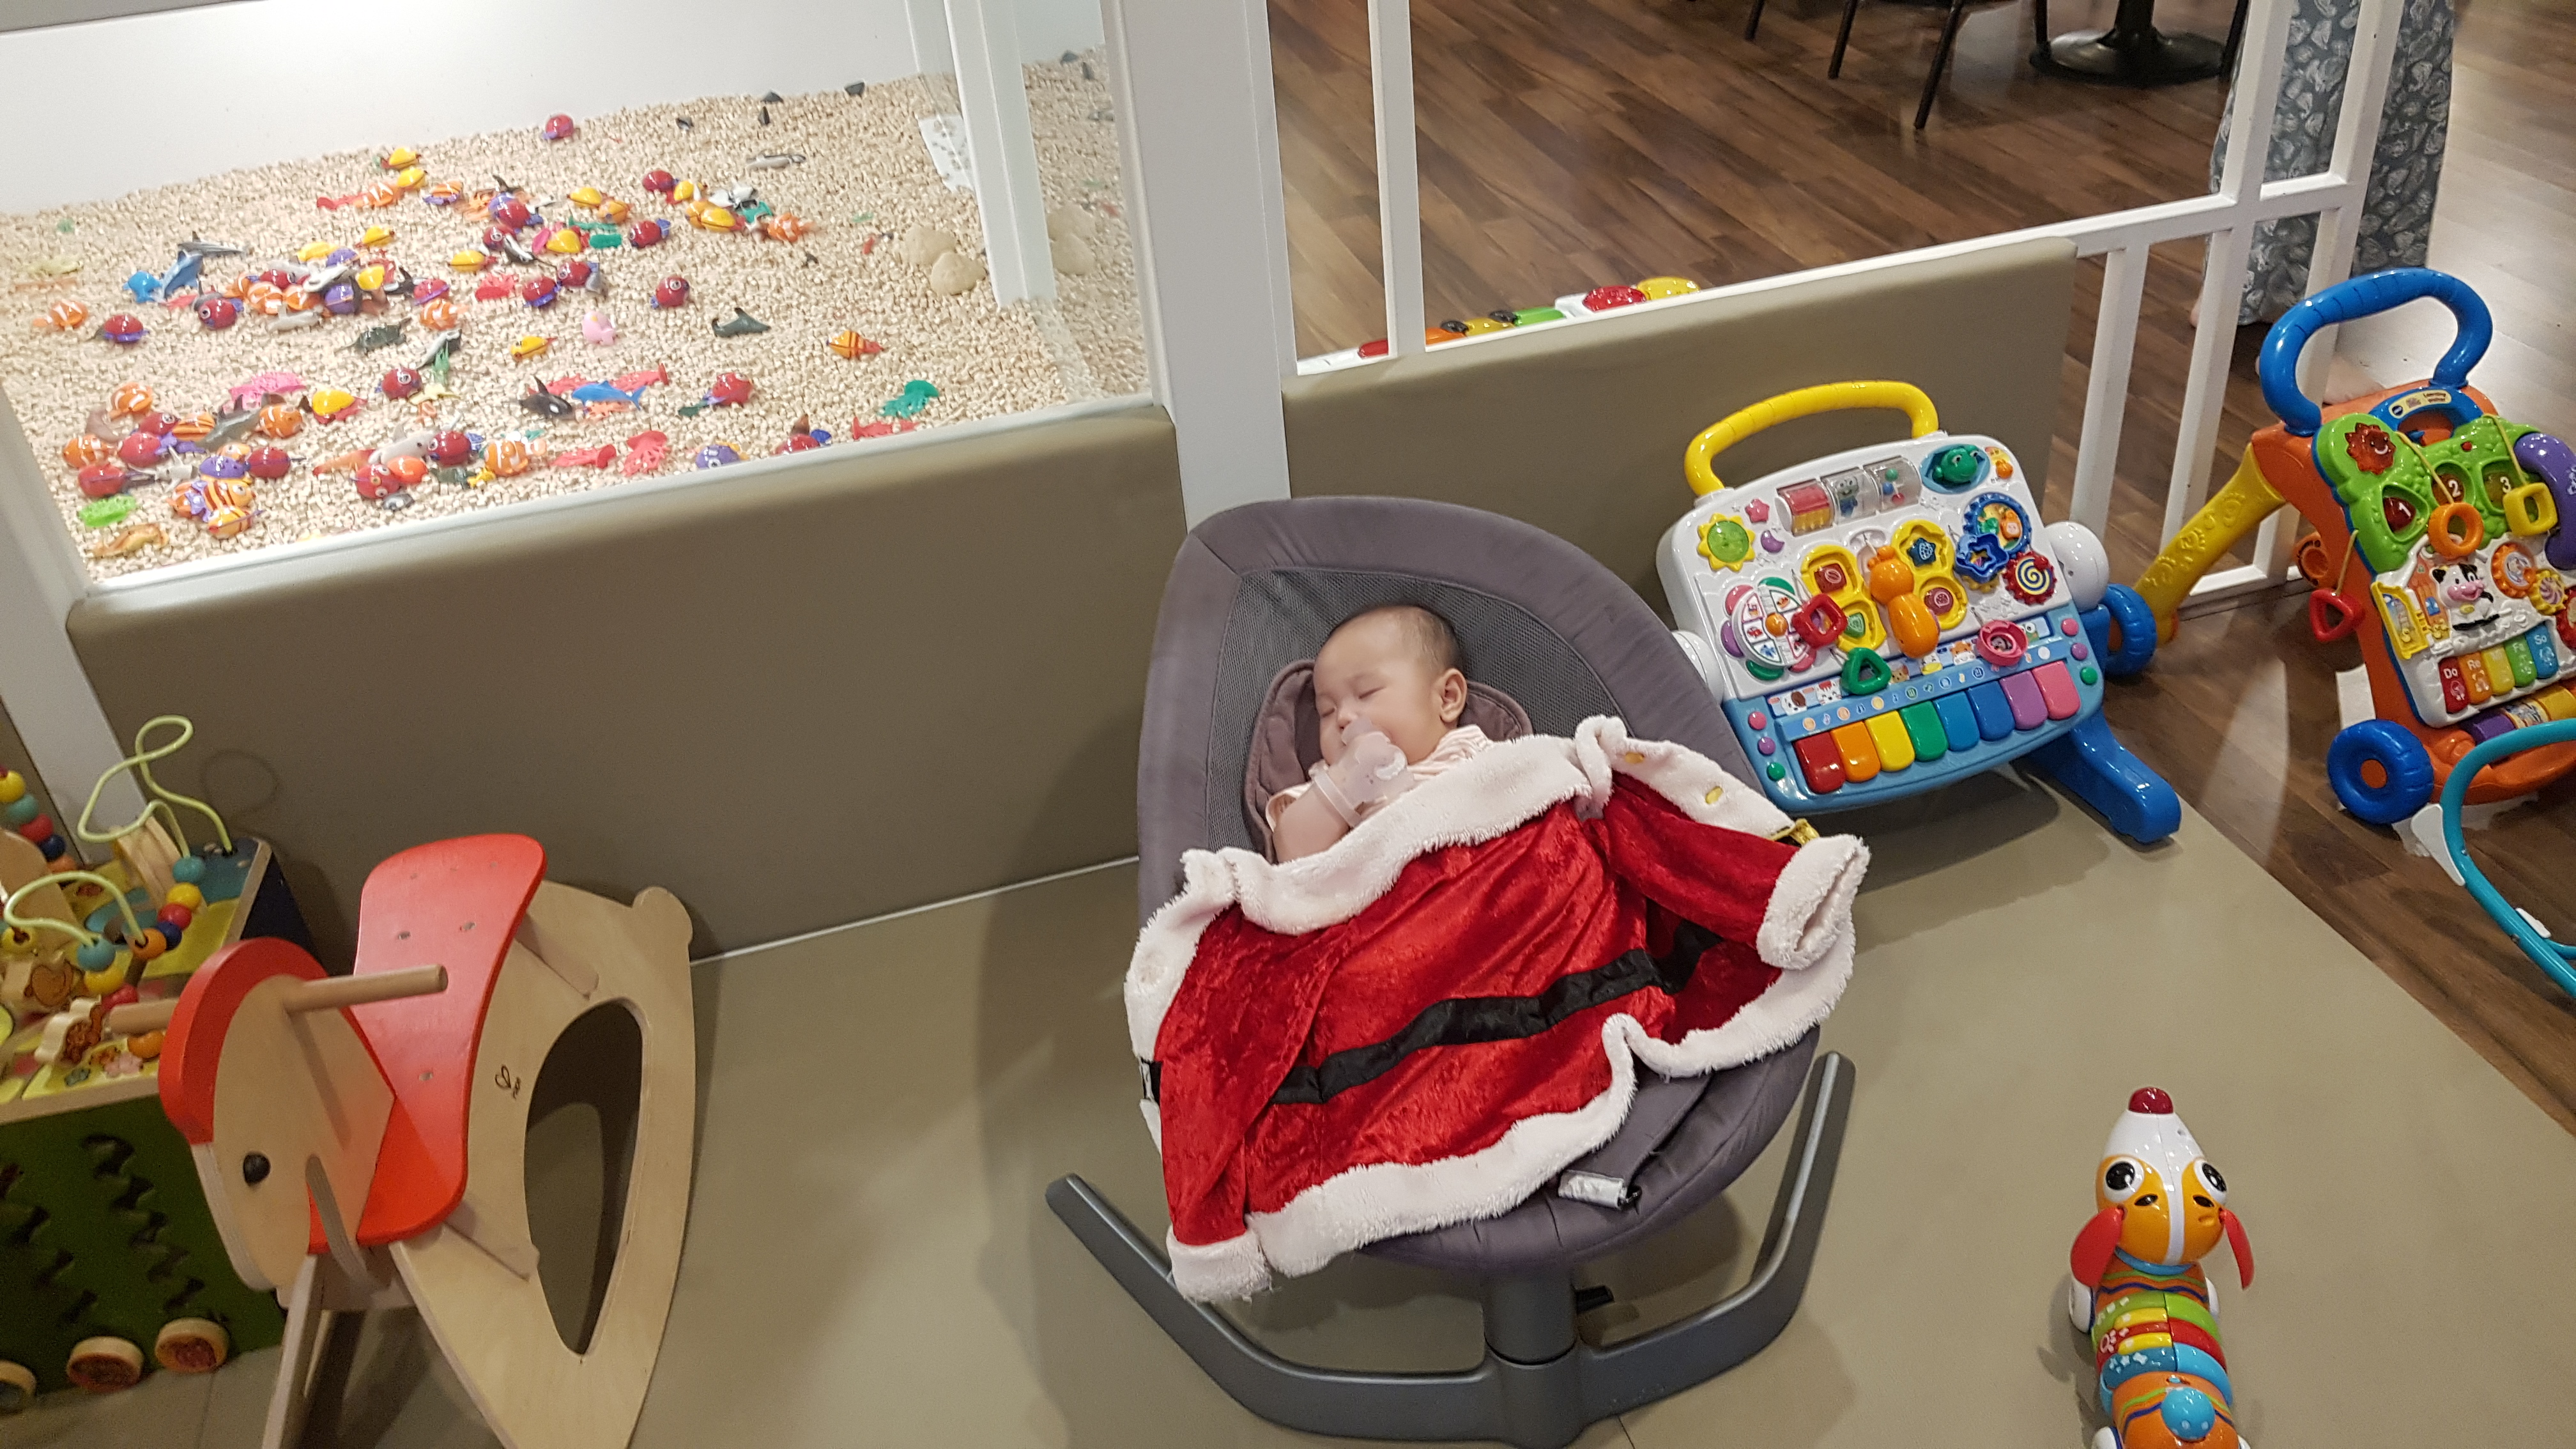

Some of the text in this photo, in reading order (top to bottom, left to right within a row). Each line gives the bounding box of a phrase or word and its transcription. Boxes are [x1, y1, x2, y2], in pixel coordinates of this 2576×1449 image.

[2399, 477, 2511, 518] 1 2 3
[2444, 668, 2458, 679] Do
[2467, 659, 2481, 670] Re
[2534, 634, 2547, 645] So
